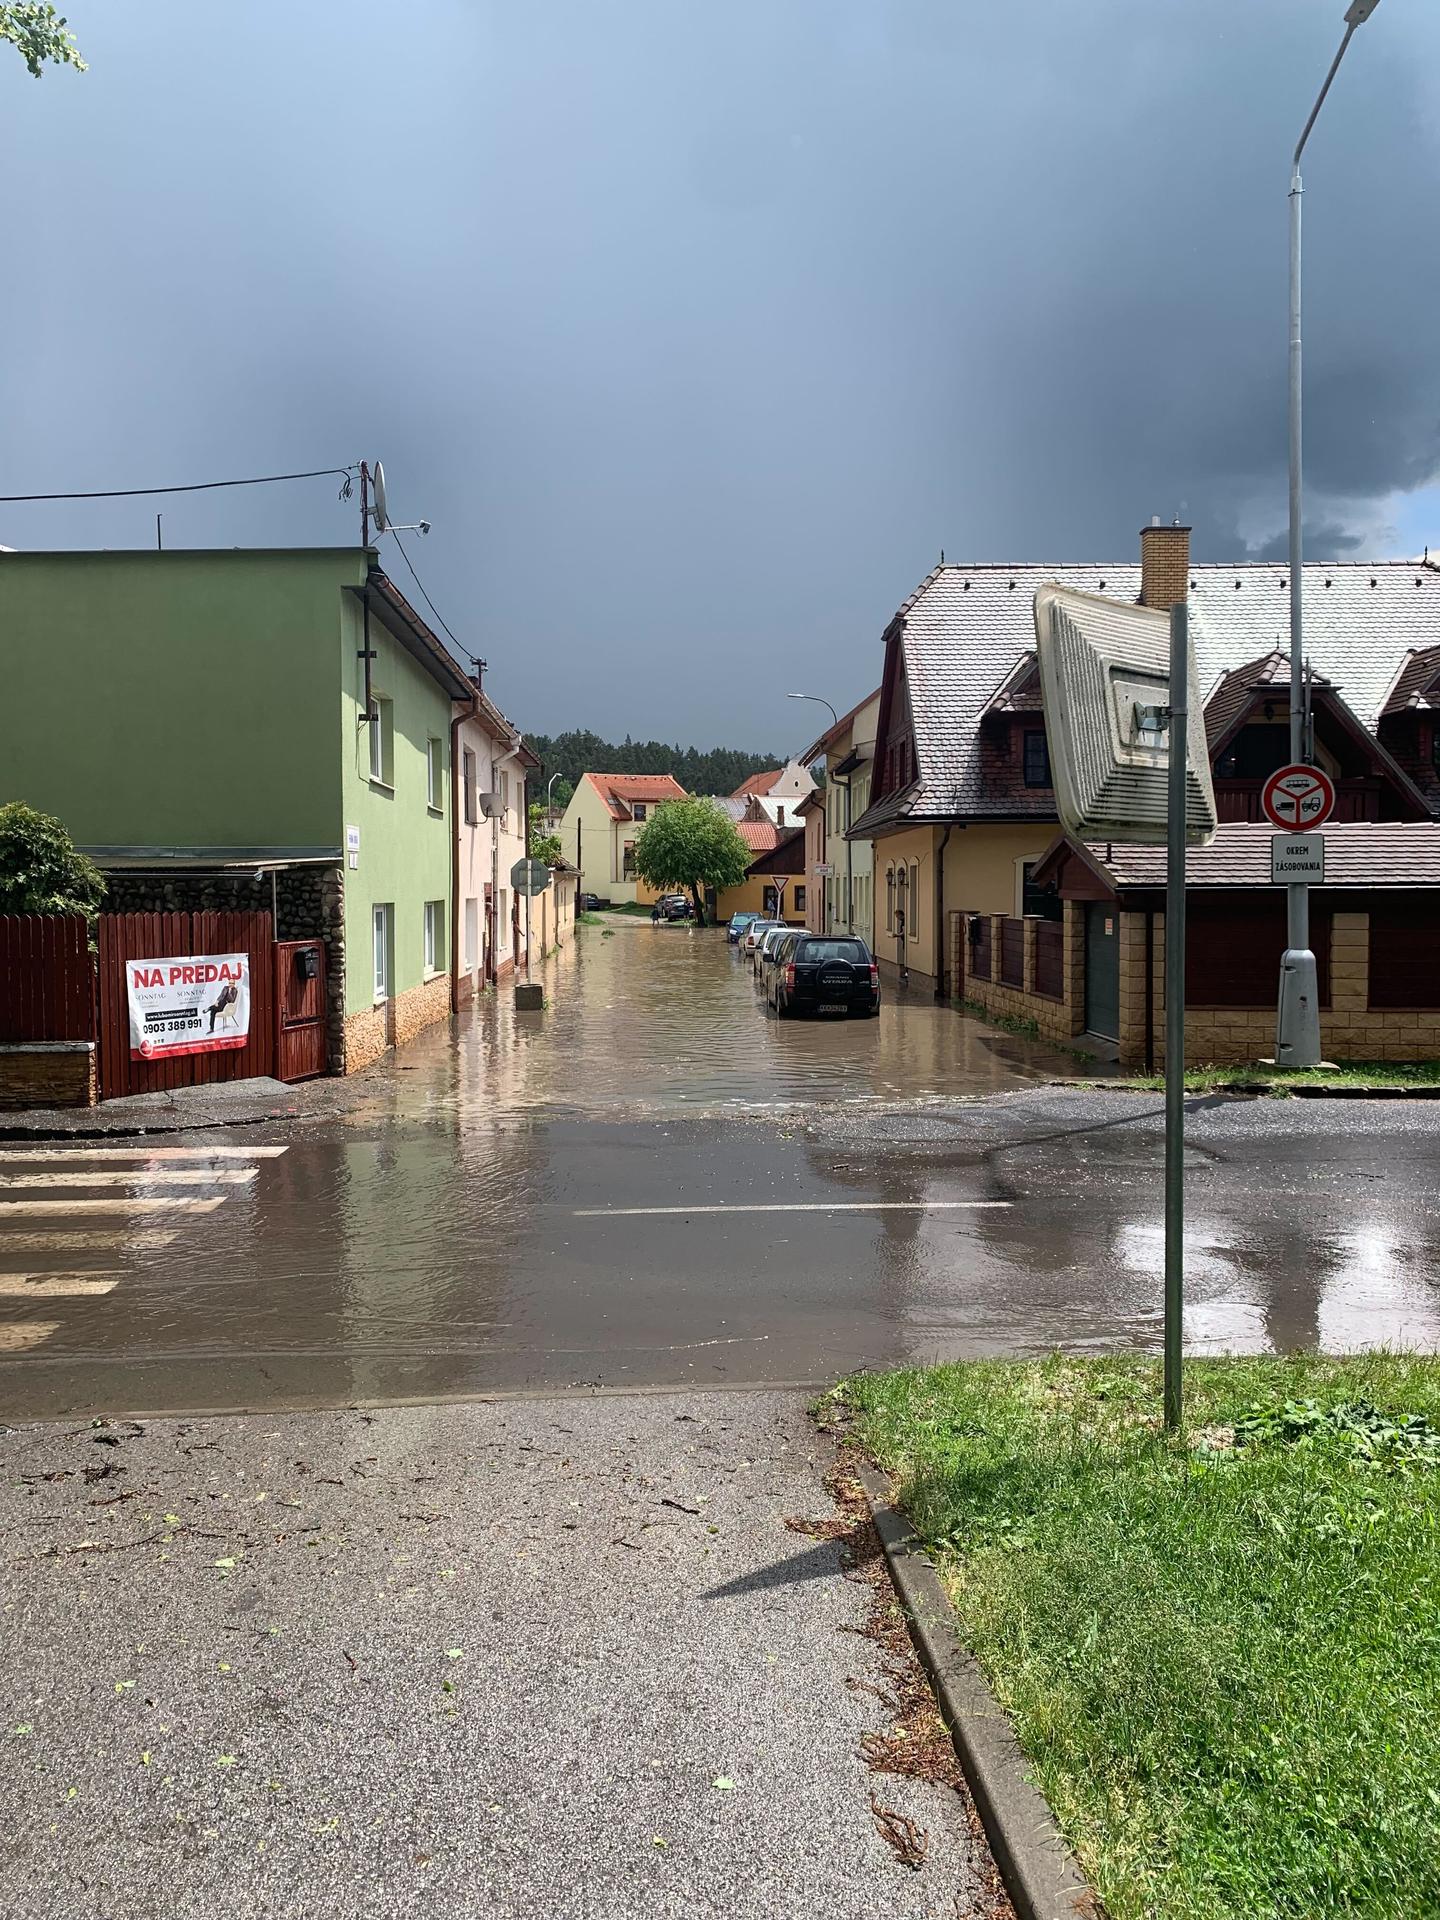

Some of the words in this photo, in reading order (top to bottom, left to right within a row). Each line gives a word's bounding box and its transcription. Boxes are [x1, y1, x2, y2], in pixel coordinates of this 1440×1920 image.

[1286, 846, 1309, 855] OKREM
[1275, 860, 1321, 871] ZÁSOBOVANIA
[133, 968, 165, 988] NA
[169, 962, 242, 985] PREDAJ
[143, 1022, 166, 1034] 0903
[168, 1020, 186, 1031] 389
[187, 1018, 202, 1028] 991
